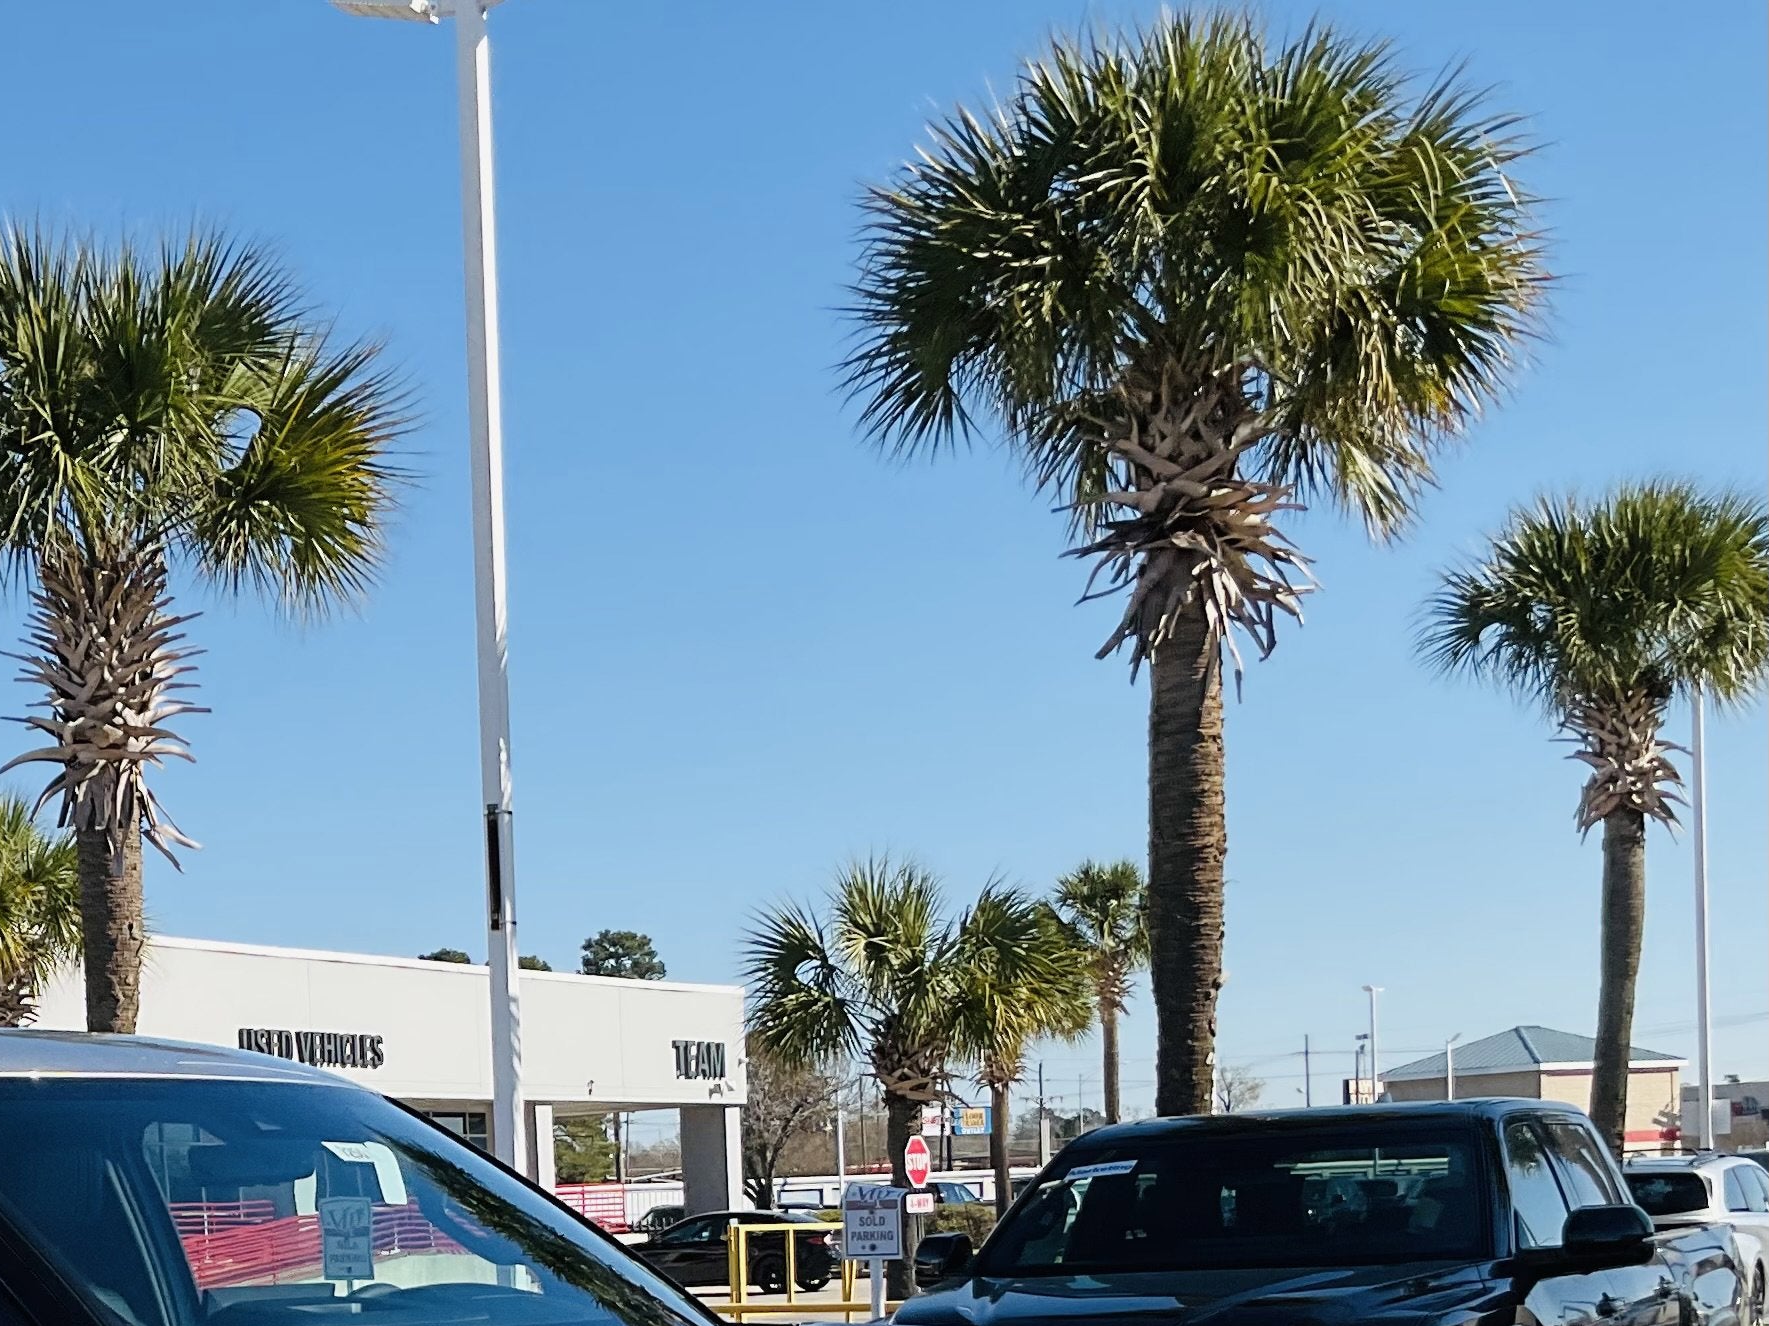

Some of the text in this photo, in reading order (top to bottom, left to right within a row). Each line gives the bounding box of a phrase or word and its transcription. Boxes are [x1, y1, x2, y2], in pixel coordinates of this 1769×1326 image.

[295, 1031, 384, 1069] VEHICLES
[672, 1040, 725, 1080] TEAM
[907, 1152, 929, 1171] STOP
[858, 1216, 886, 1227] SOLD
[851, 1230, 894, 1241] PARKING
